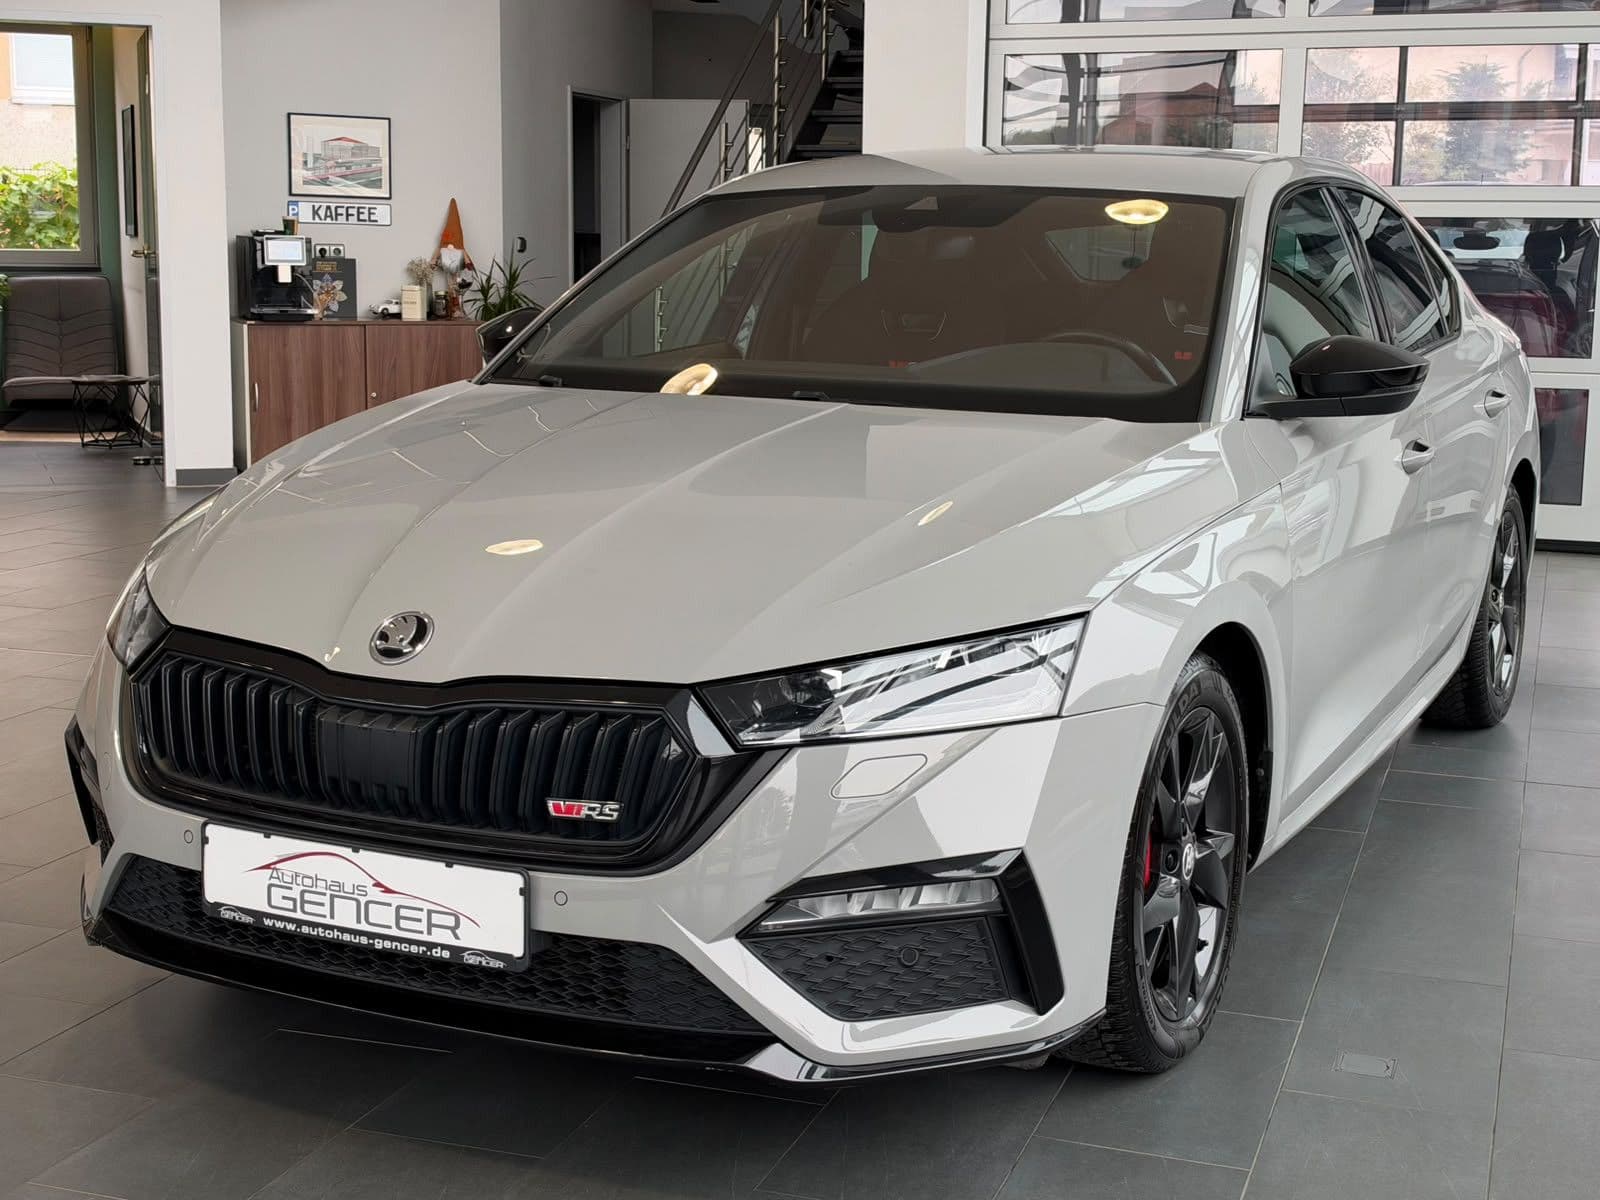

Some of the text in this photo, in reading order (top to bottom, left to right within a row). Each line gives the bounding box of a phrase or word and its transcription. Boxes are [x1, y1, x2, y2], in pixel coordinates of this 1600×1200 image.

[312, 204, 379, 222] KAFFEE
[268, 866, 368, 897] Autohaus
[267, 883, 461, 940] GENCER
[263, 917, 450, 958] www.autohaus-gencer.de
